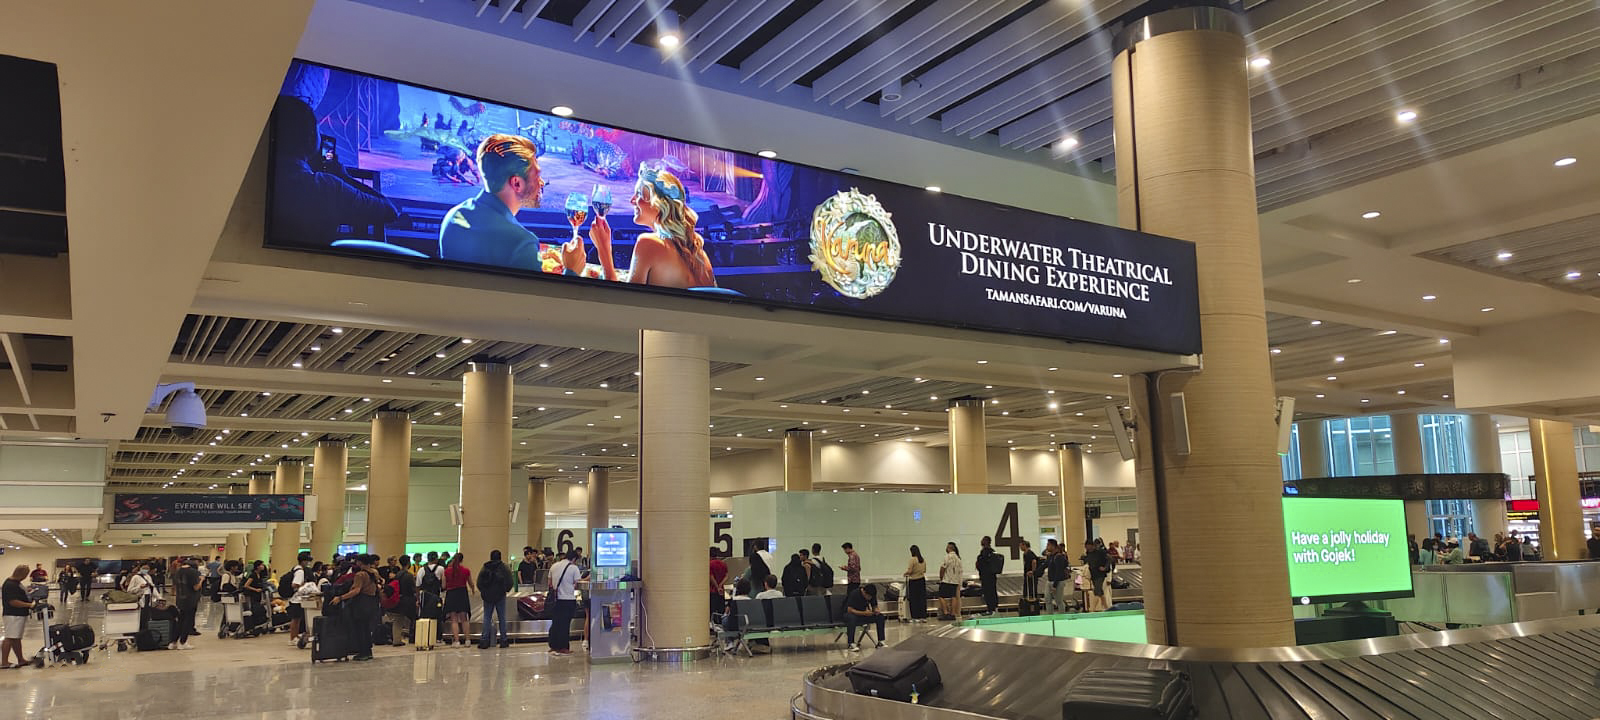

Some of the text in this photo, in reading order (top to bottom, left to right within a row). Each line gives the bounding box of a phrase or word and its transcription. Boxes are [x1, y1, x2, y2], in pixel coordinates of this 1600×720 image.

[928, 222, 1173, 285] UNDERWATER THEATRICAL
[960, 252, 1150, 302] DINING EXPERIENCE
[986, 288, 1127, 319] TAMANSAFARI.COM/VARUNA
[174, 502, 253, 510] EVERYONE WILL SEE
[557, 529, 574, 554] 6
[713, 521, 733, 557] 5
[994, 502, 1024, 560] 4
[1291, 530, 1390, 547] Have a jolly holiday
[1293, 548, 1356, 565] with Gojek!
